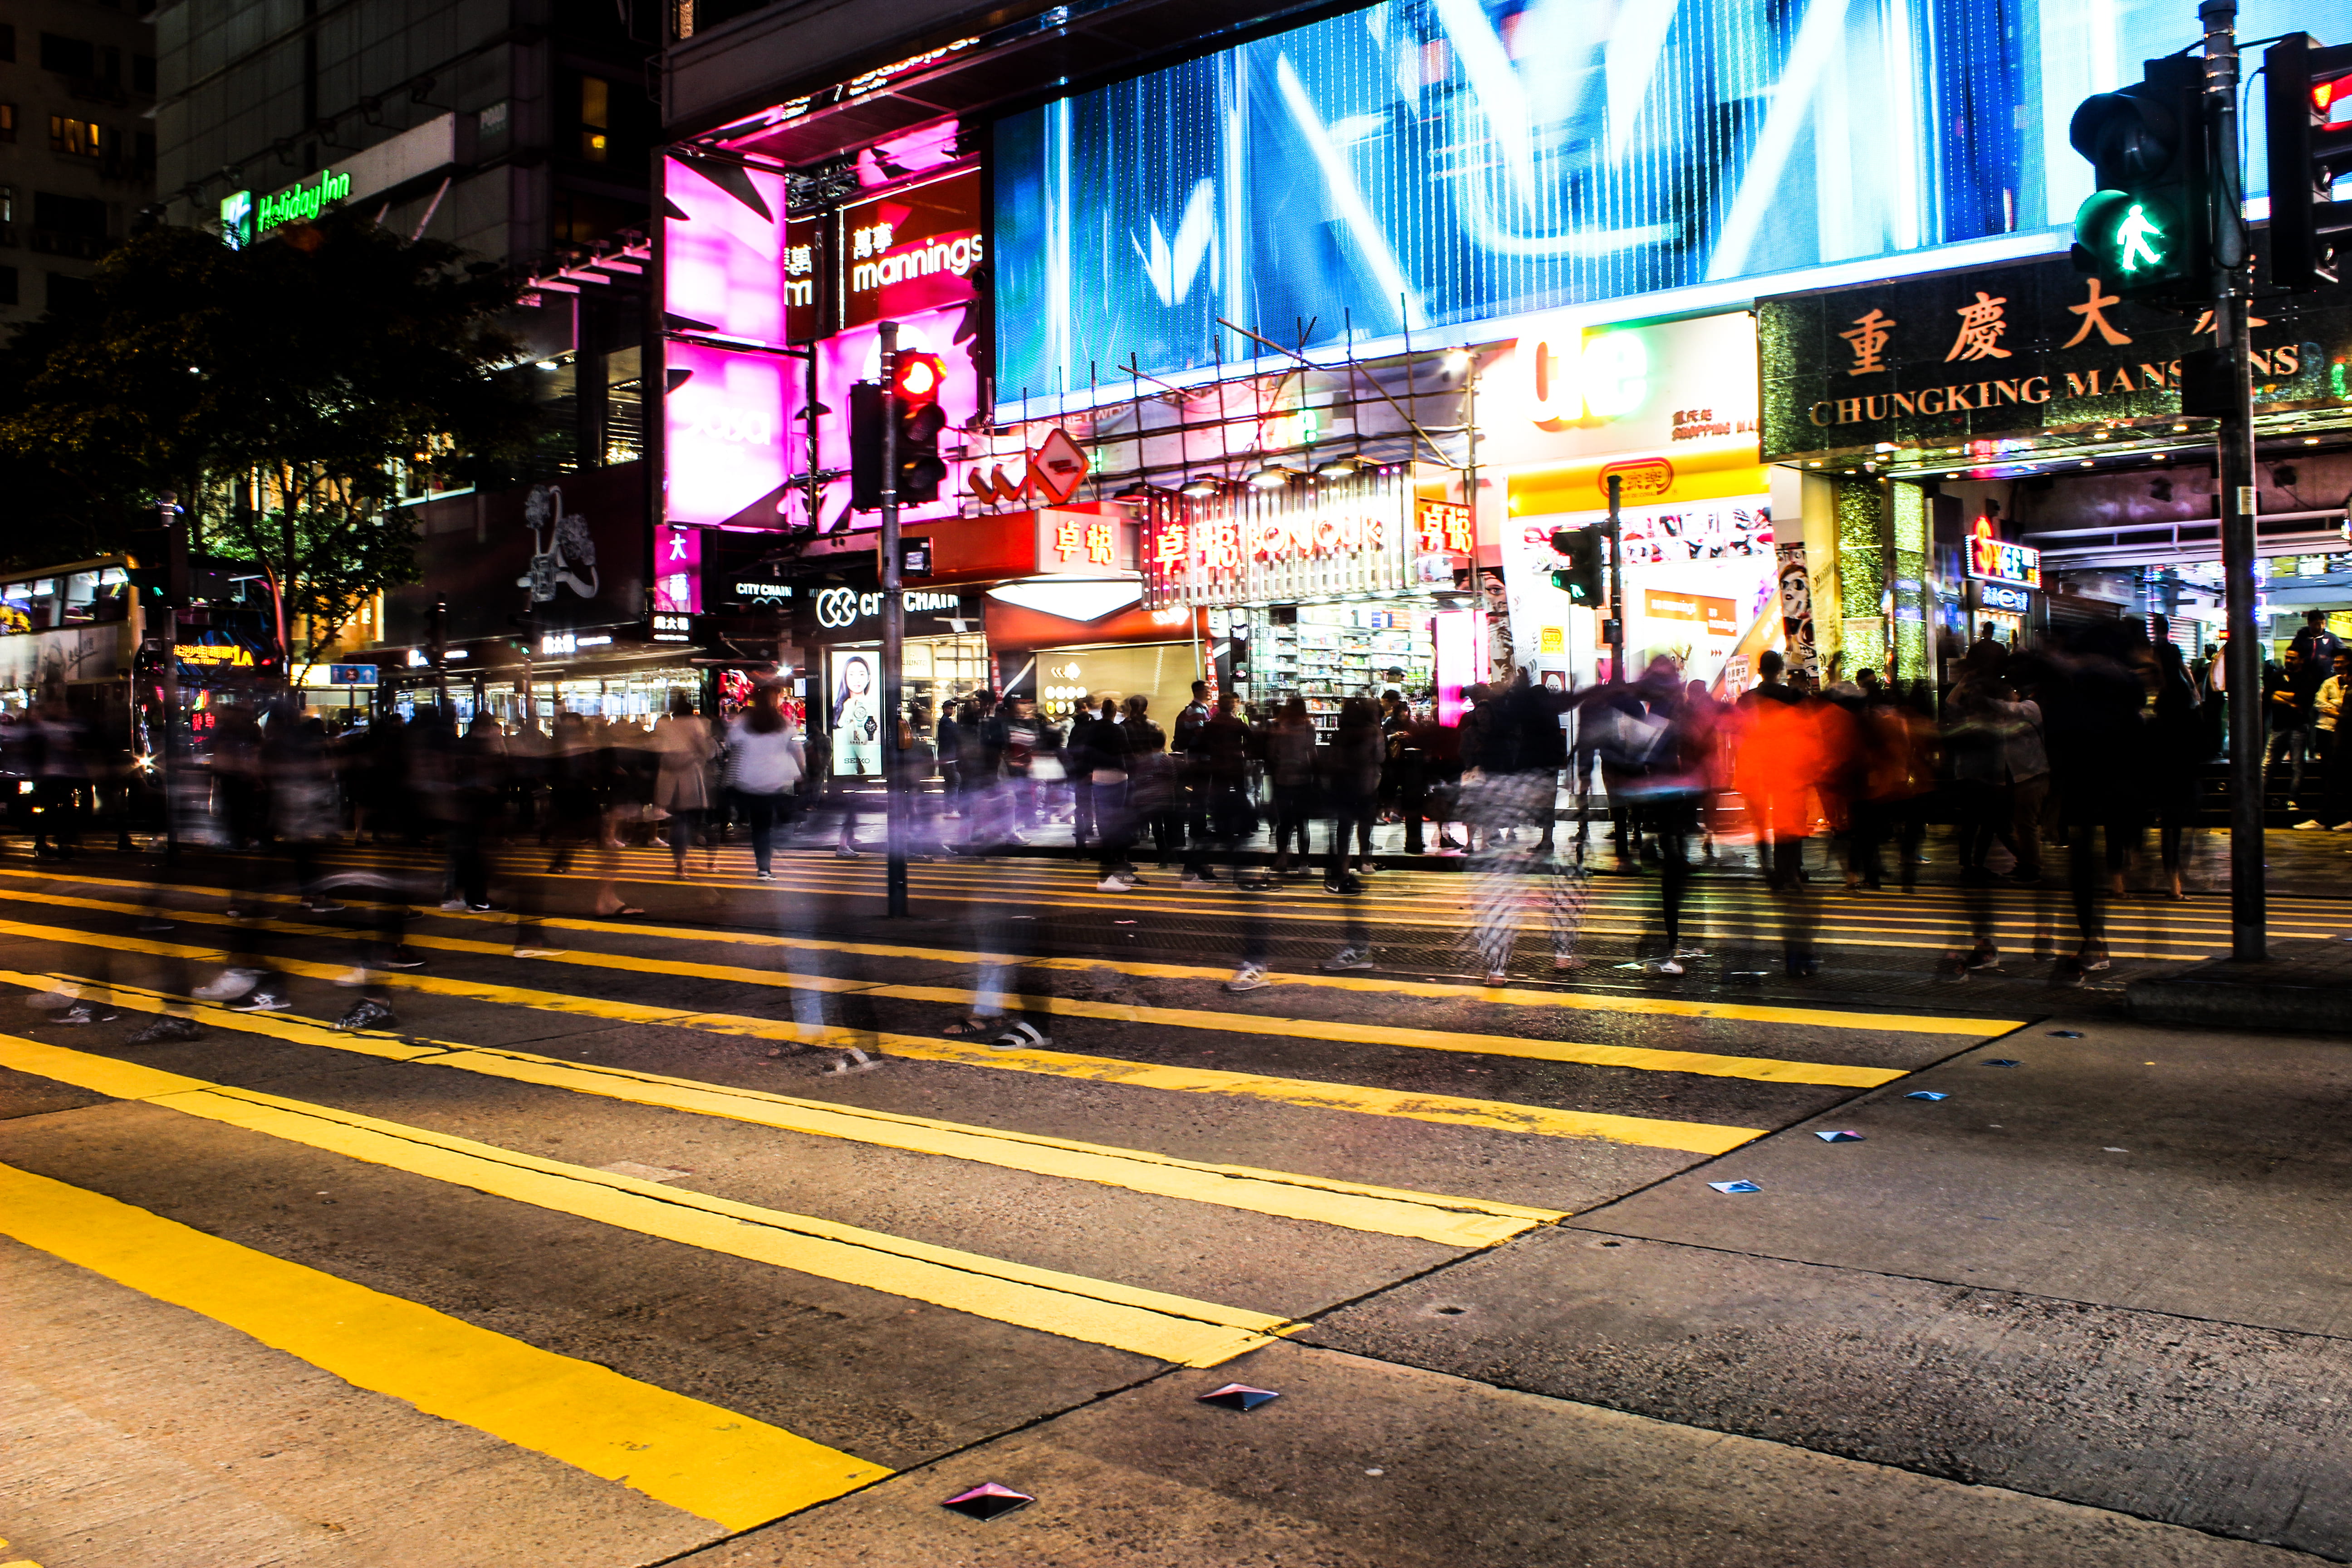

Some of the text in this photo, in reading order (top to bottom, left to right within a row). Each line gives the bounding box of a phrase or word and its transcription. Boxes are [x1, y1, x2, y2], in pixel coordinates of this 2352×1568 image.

[257, 169, 349, 232] Holiday Inn
[853, 222, 893, 260] 萬寧
[853, 234, 983, 292] mannings
[1810, 376, 2050, 427] CHUNGKING
[1672, 421, 1730, 441] SHOPPING
[1248, 515, 1383, 555] BONJOUR
[736, 583, 792, 597] CITY CHAIN
[902, 592, 959, 612] CHAIN
[230, 644, 255, 666] 1A
